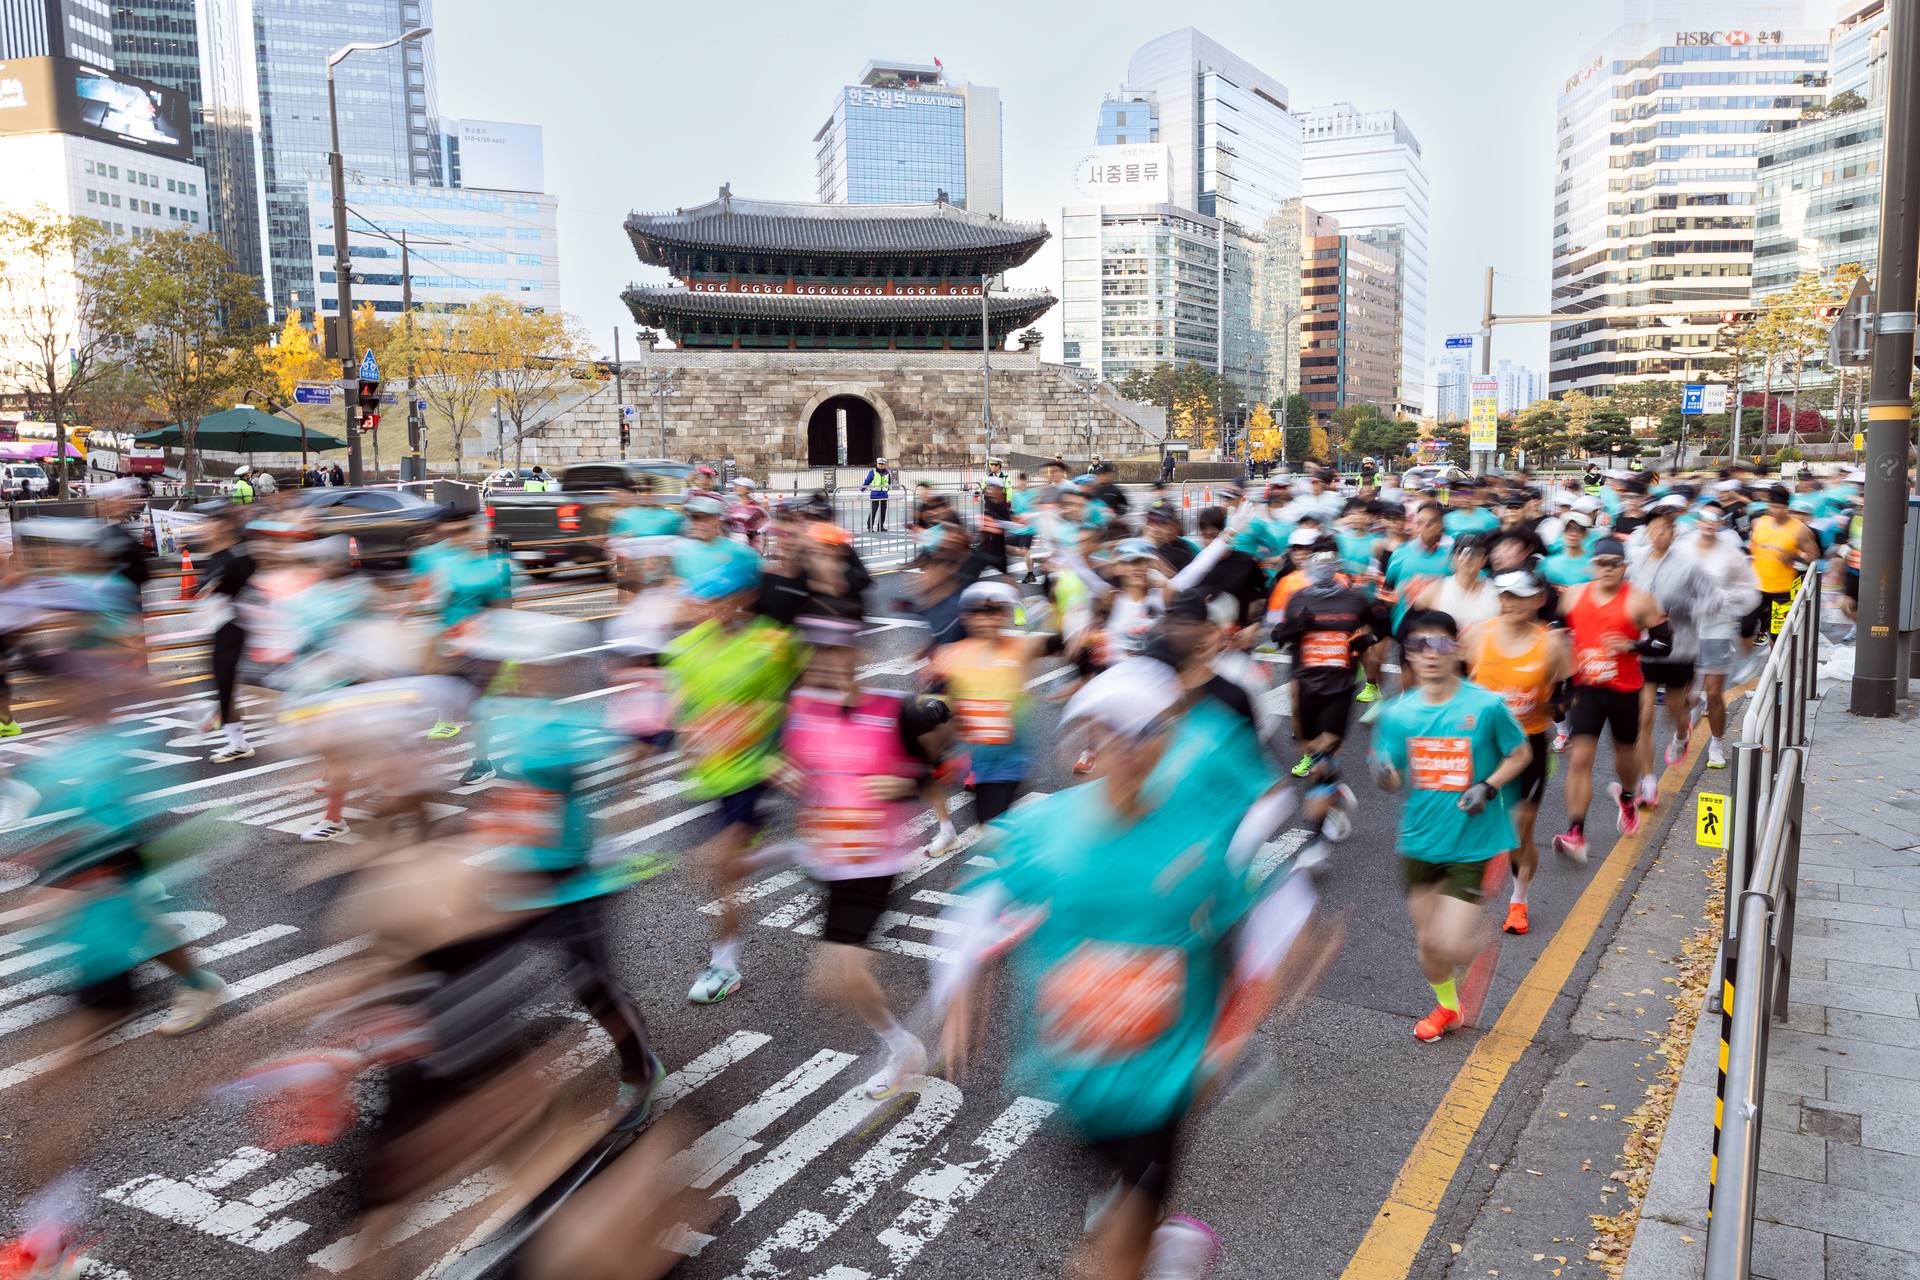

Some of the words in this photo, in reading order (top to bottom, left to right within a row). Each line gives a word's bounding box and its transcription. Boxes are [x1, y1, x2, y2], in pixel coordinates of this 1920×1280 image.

[1676, 31, 1723, 46] HSBC
[1757, 30, 1782, 44] 은행
[848, 88, 907, 108] 한국일보
[1088, 163, 1158, 183] 서중물류
